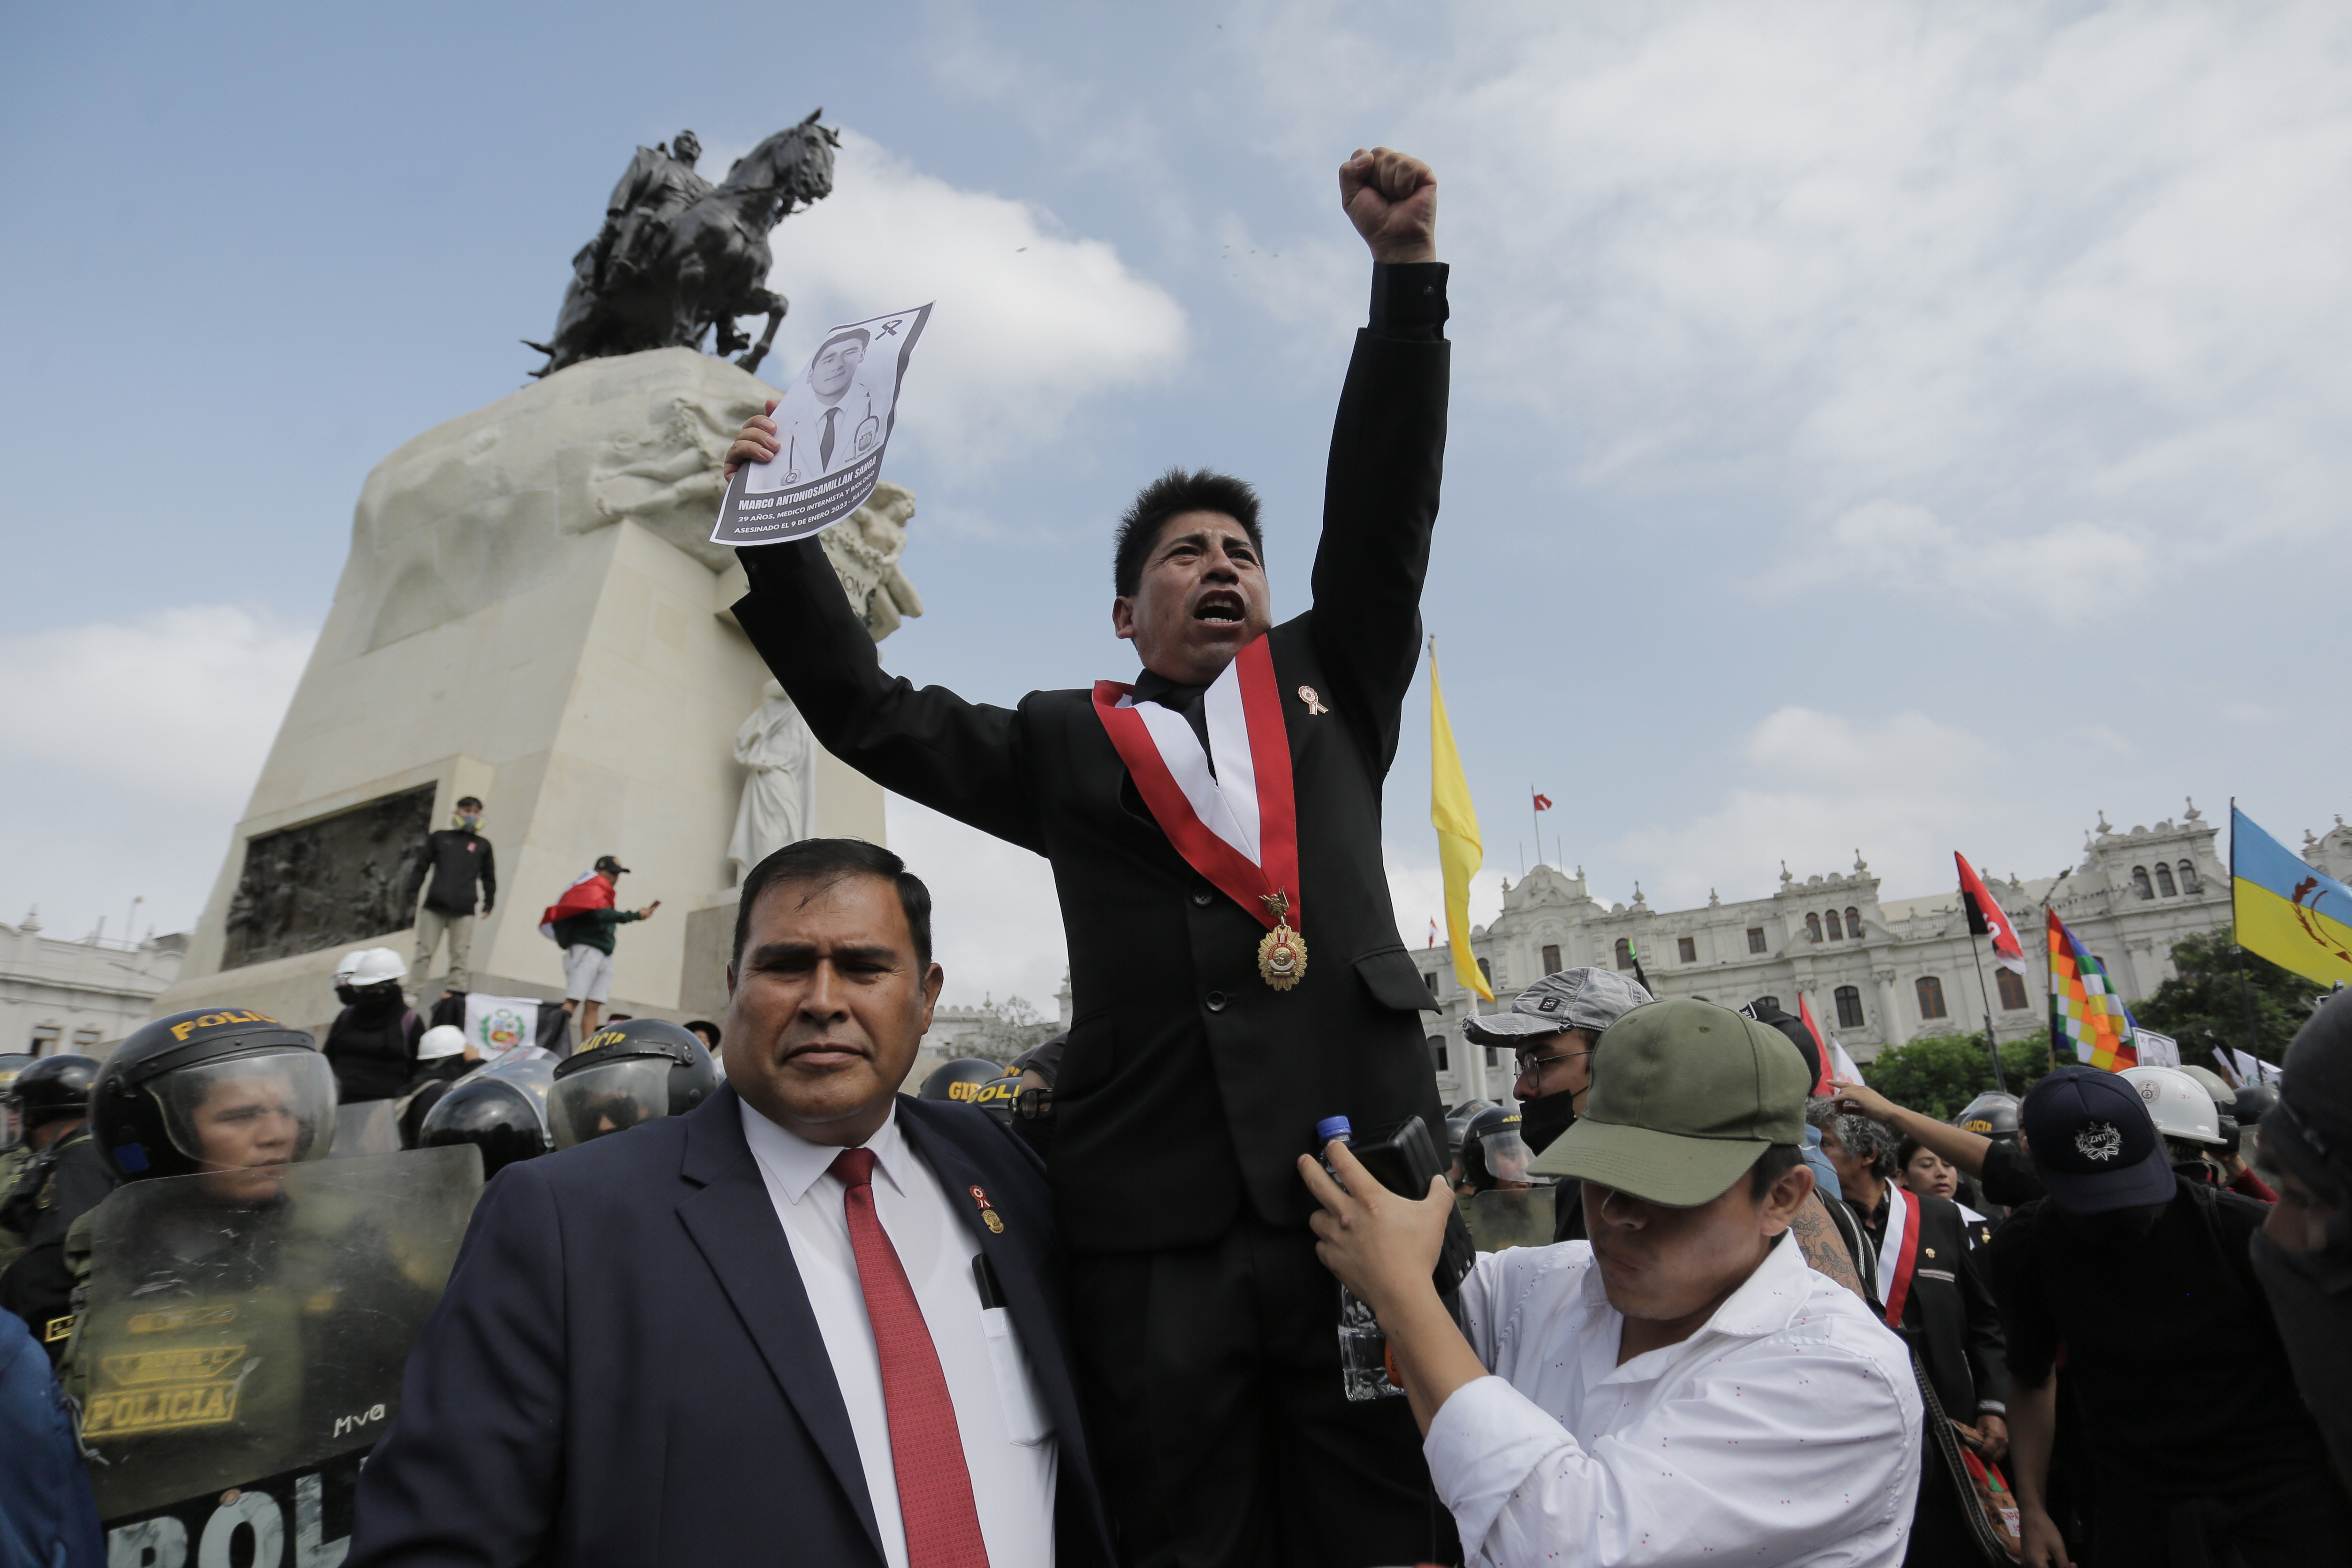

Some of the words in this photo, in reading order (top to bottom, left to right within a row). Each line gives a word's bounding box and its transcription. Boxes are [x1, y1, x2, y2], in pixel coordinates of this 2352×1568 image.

[734, 524, 780, 533] ASESINADO
[807, 510, 830, 523] ENERO
[831, 500, 847, 514] 2023
[851, 482, 872, 502] JULIACA
[738, 498, 774, 510] MARCO
[776, 472, 853, 506] ANTONIOSAMILLAN
[854, 456, 877, 479] SANGA
[750, 513, 775, 521] AÑOS,
[776, 507, 805, 518] MEDICO
[807, 492, 844, 511] INTERNISTA
[850, 470, 875, 492] BIOLOGO
[87, 1388, 227, 1431] POLICIA
[108, 1457, 368, 1568] POL
